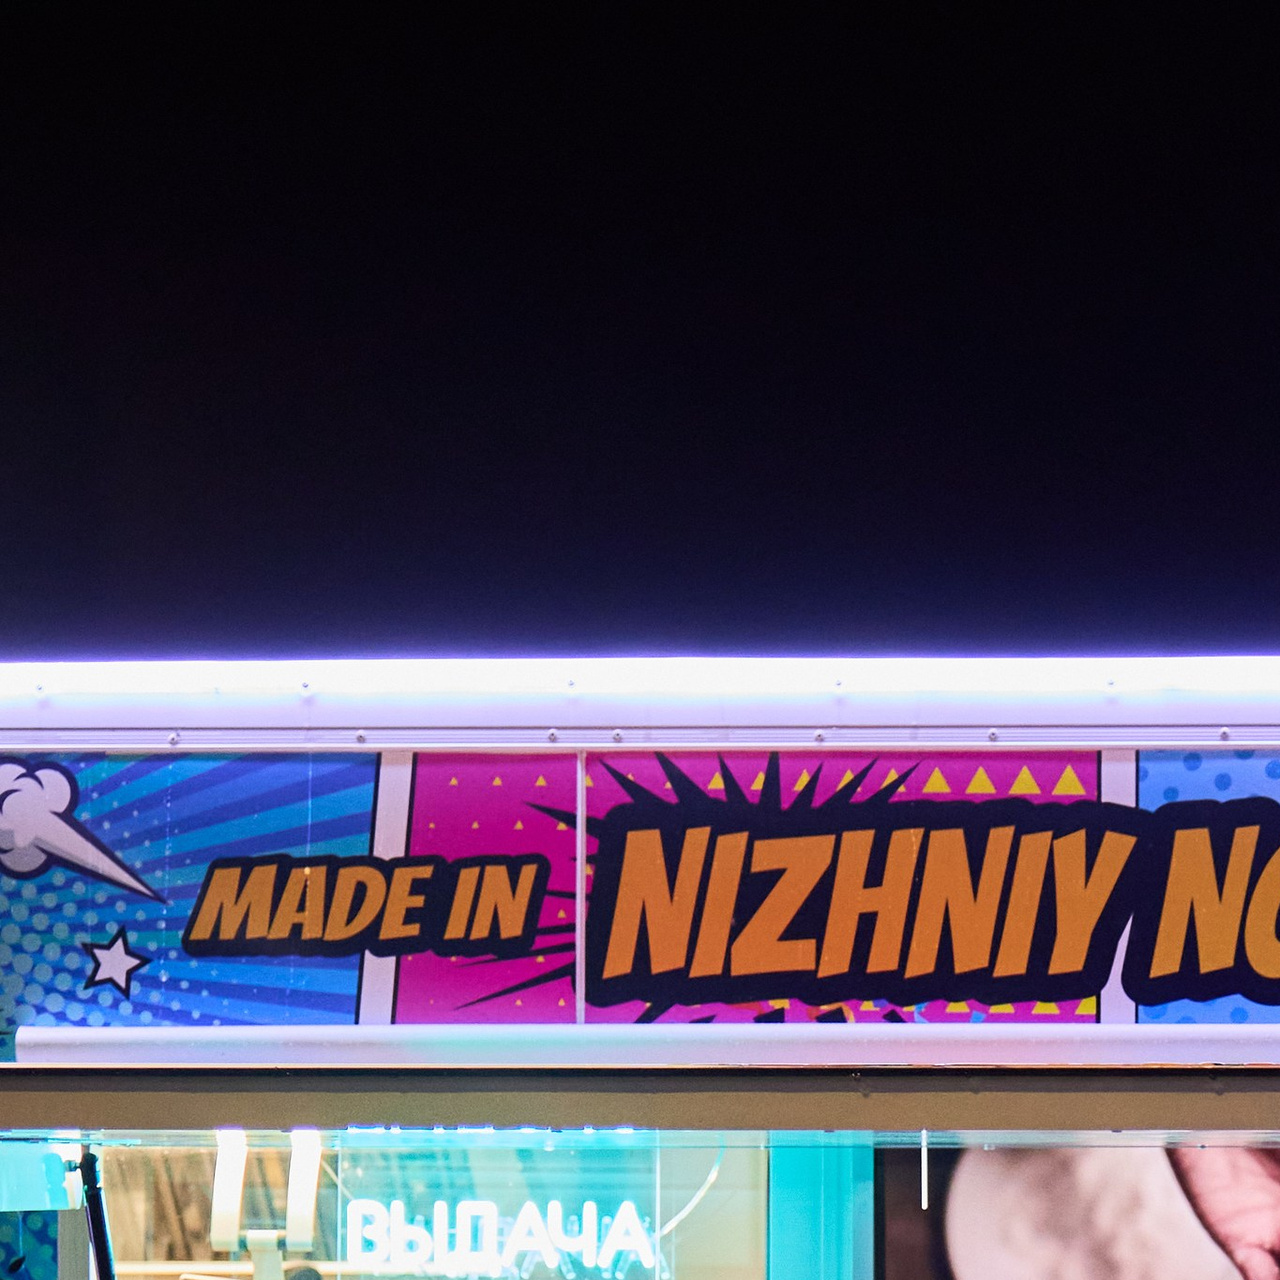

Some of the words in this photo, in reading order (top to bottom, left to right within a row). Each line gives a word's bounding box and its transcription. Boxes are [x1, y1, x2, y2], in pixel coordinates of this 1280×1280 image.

[187, 862, 432, 943] MADE
[443, 865, 540, 942] IN
[602, 826, 1135, 982] NIZHNIY
[346, 1199, 656, 1277] ВЫДАЧА
